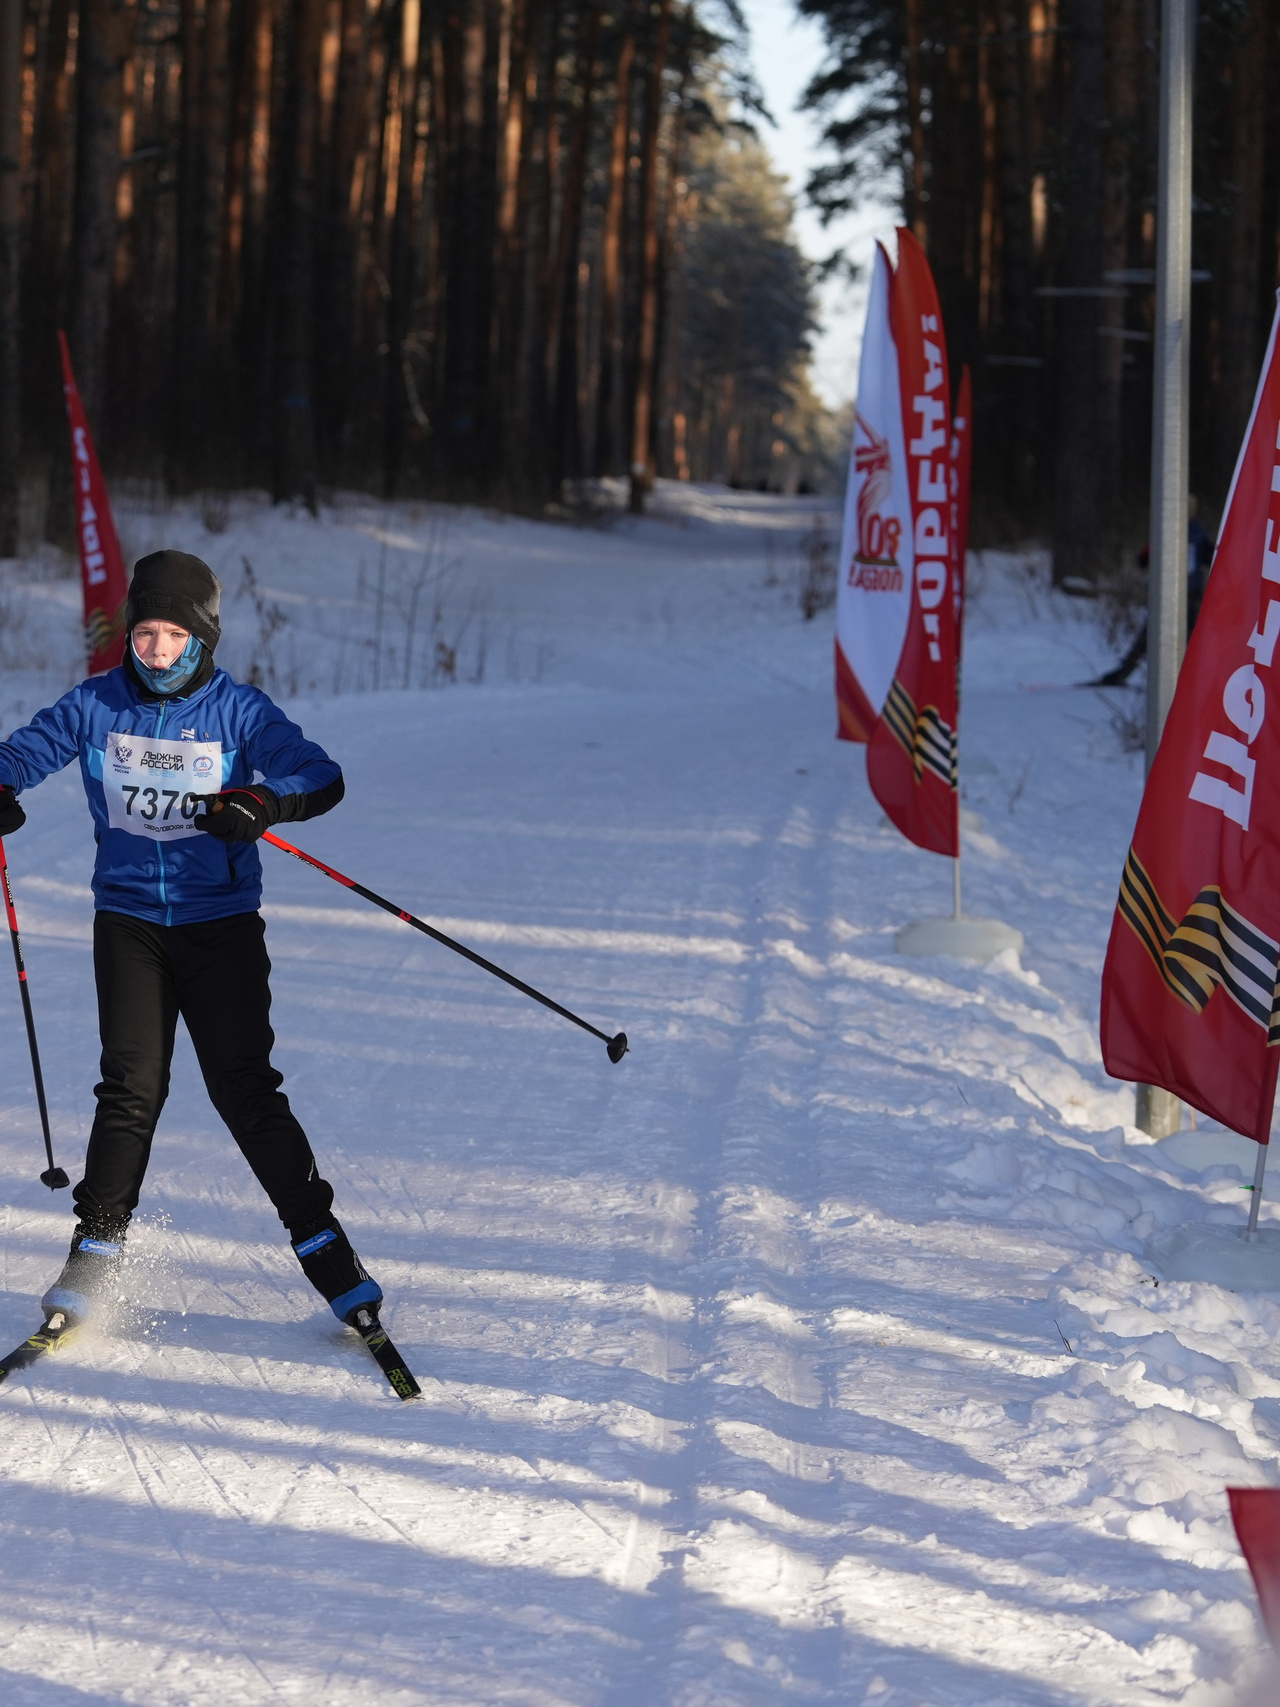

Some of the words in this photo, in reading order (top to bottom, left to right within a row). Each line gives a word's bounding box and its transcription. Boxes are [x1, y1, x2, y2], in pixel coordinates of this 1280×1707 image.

[142, 750, 183, 763] ЛЫЖНЯ
[140, 758, 184, 771] РОССИИ
[122, 785, 198, 820] 7370
